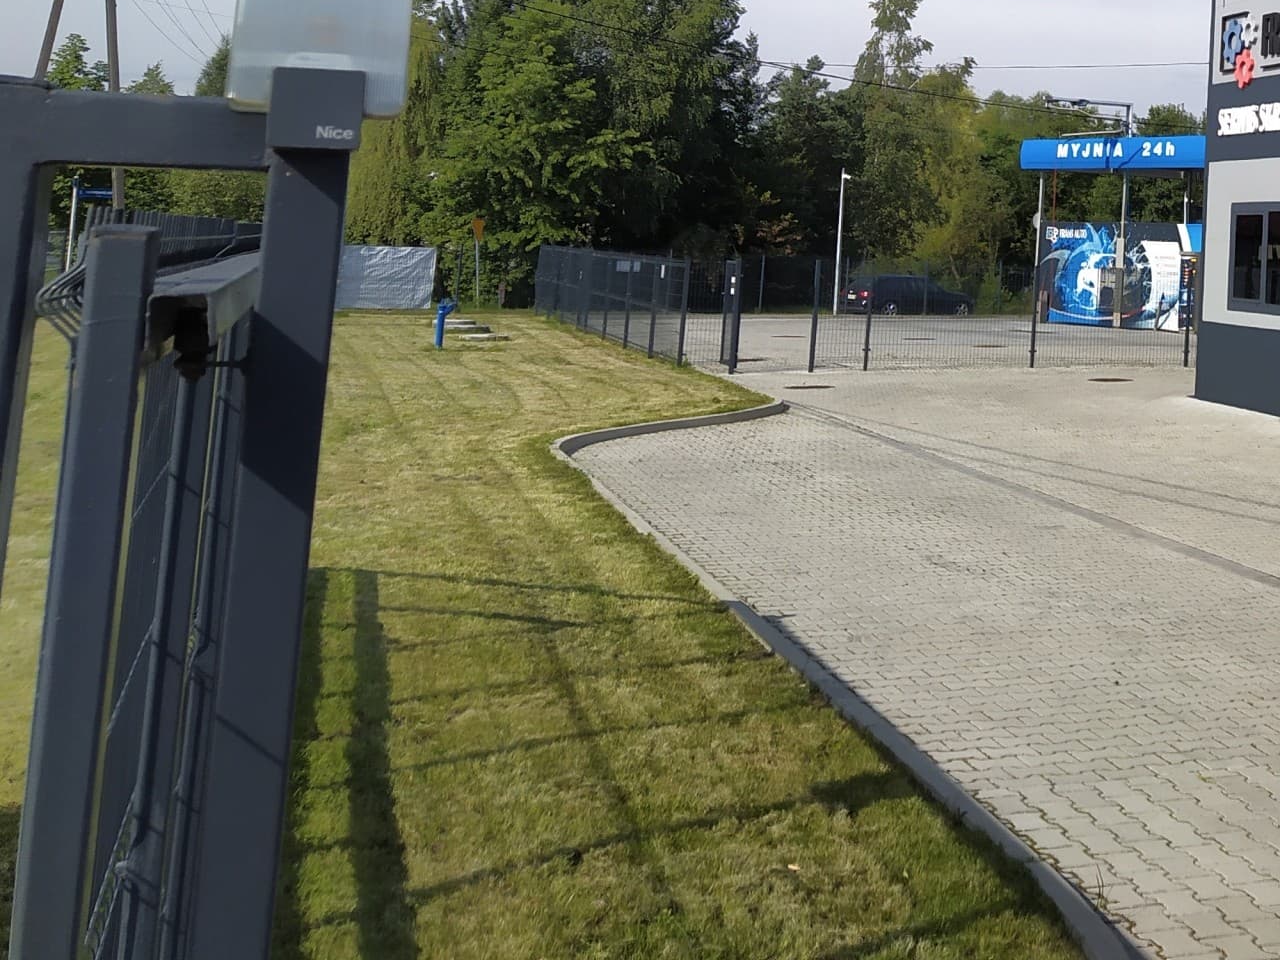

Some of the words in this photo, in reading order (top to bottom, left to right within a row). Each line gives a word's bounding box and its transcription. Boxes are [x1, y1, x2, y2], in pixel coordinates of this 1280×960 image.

[315, 125, 354, 140] Nice
[1056, 142, 1123, 158] MYJNIA
[1141, 141, 1175, 157] 24h
